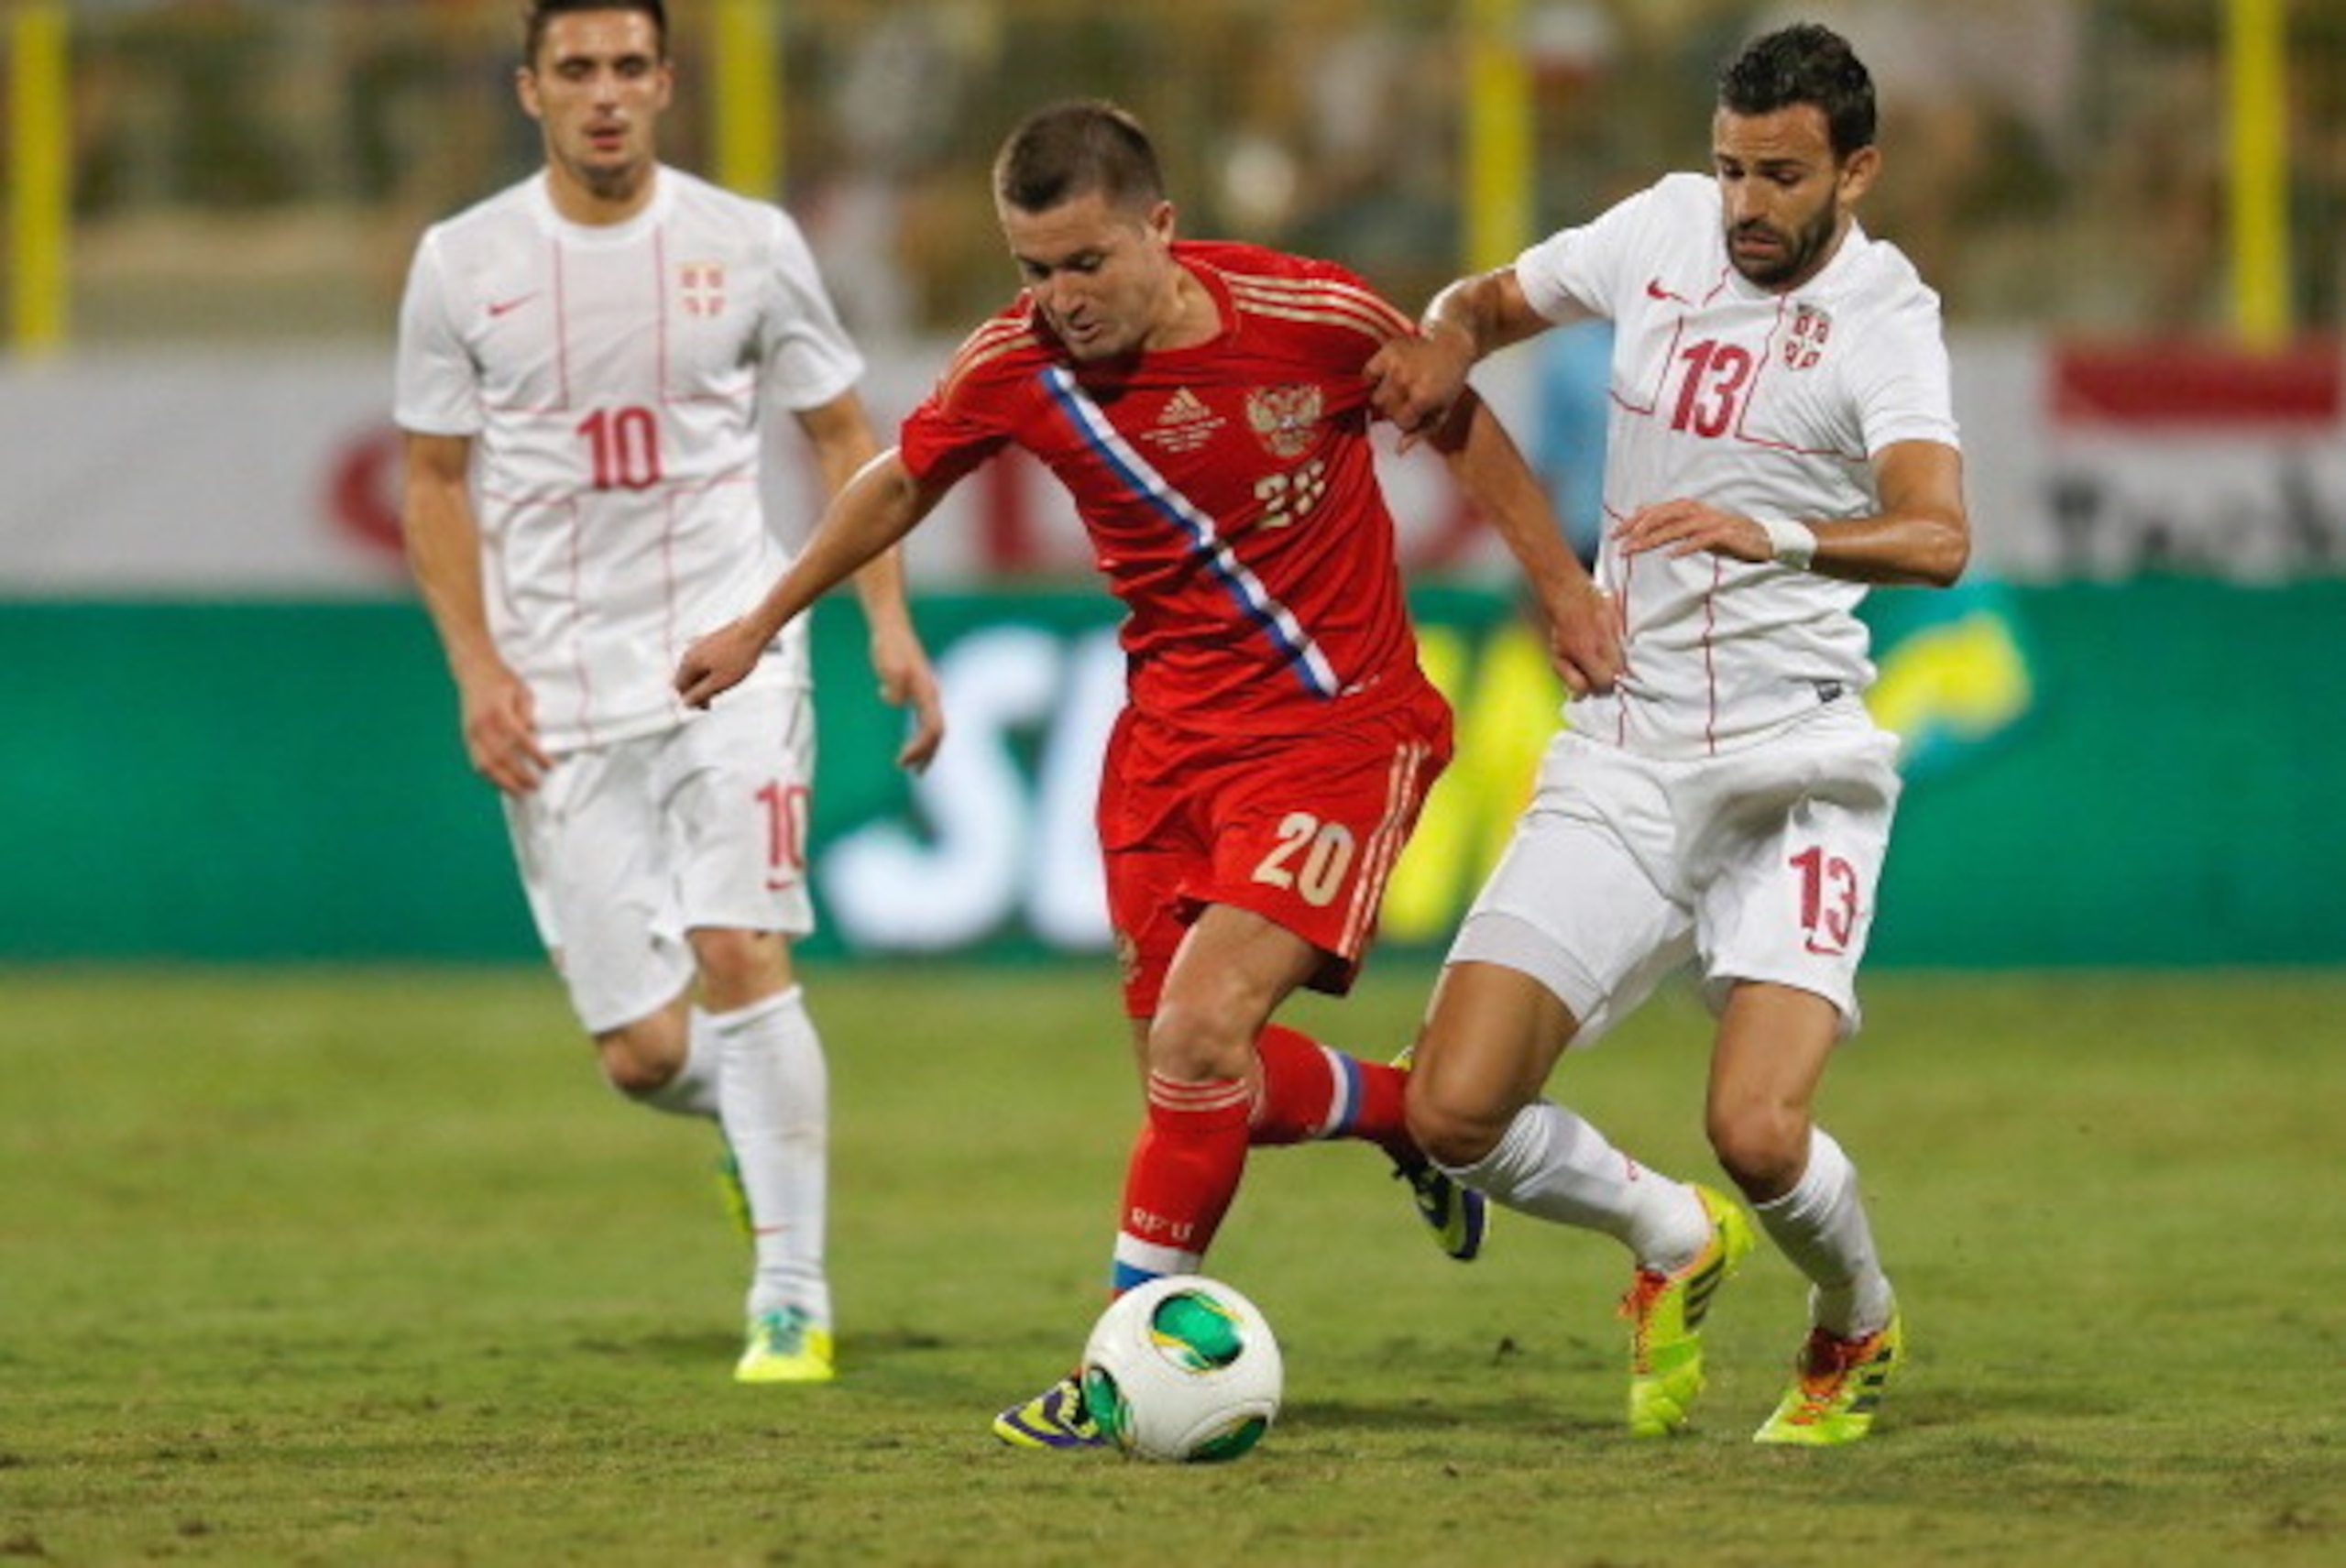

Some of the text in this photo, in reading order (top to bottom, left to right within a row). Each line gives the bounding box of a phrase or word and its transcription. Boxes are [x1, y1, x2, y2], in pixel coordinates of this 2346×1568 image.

[1671, 340, 1752, 438] 13
[576, 406, 661, 490] 10
[1251, 812, 1354, 906] 20
[1790, 845, 1857, 948] 13
